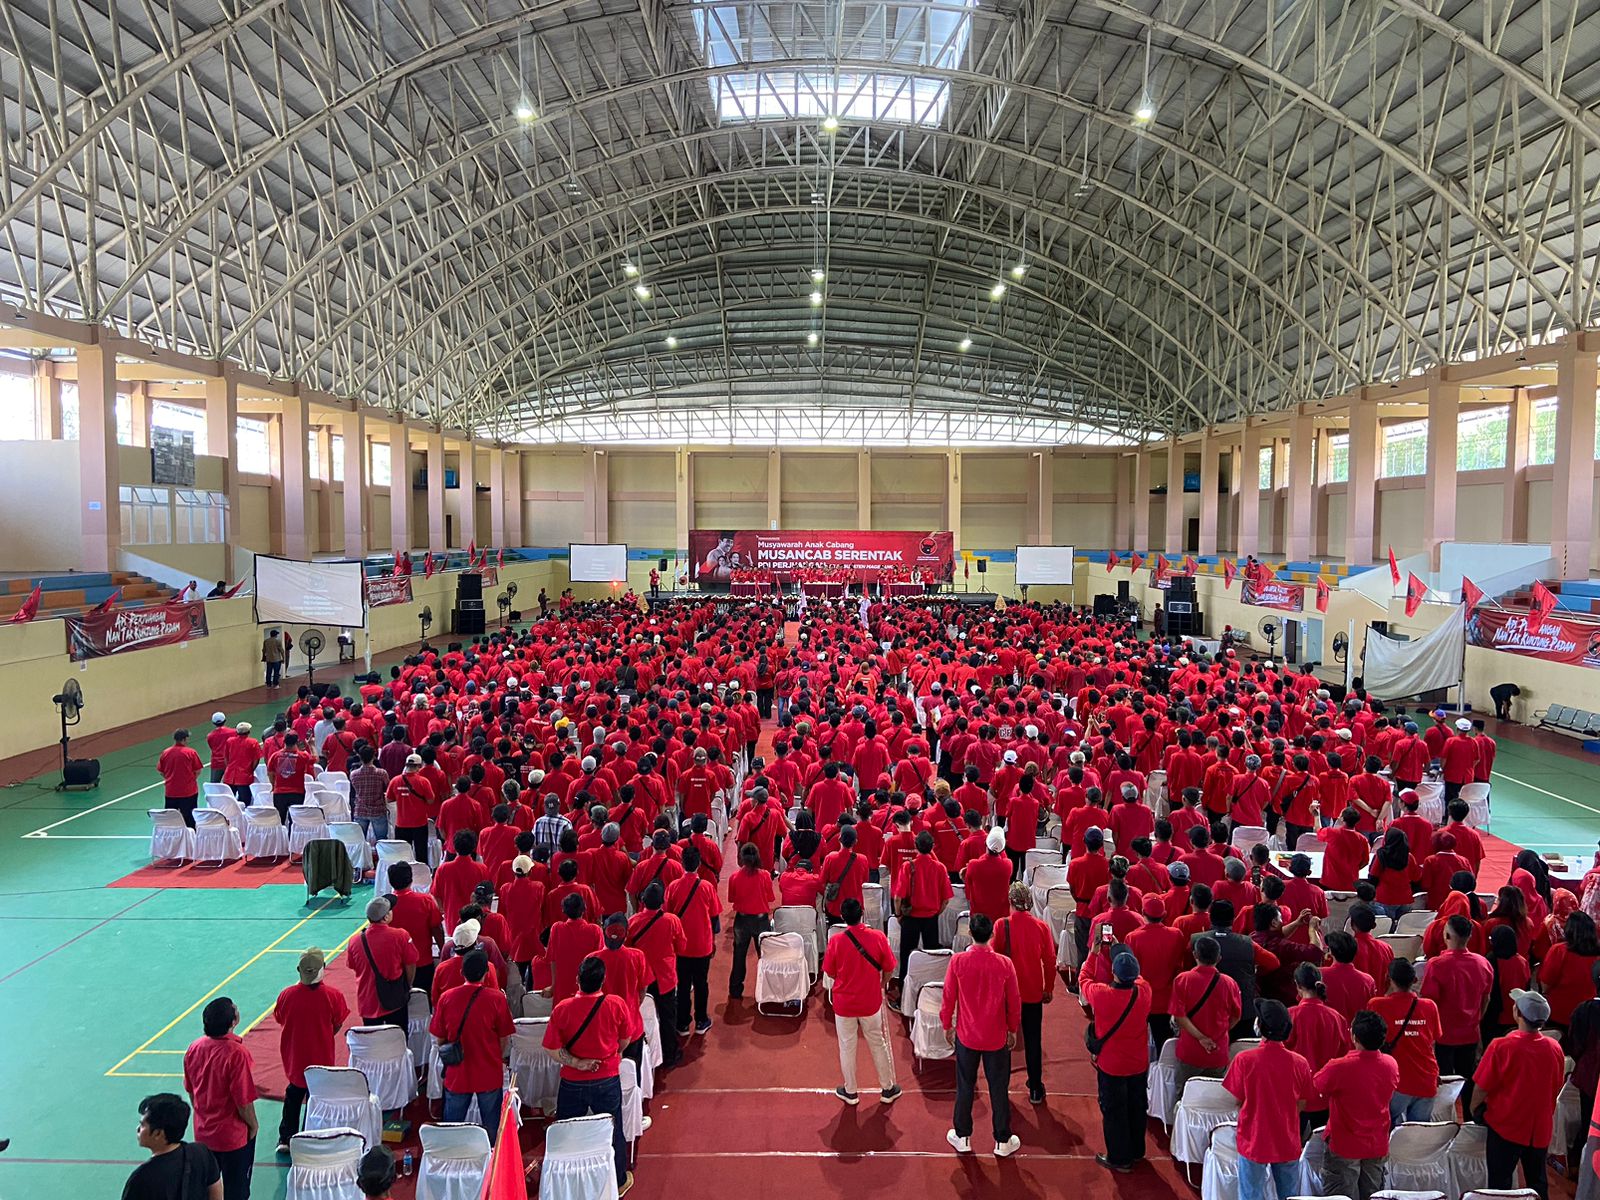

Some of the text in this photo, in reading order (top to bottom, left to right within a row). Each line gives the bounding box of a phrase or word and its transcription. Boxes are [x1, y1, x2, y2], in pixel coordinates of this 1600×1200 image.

[757, 541, 803, 549] Musyawarah
[825, 541, 855, 549] Cabang
[758, 550, 832, 560] MUSANCAB
[834, 550, 903, 561] SERENTAK
